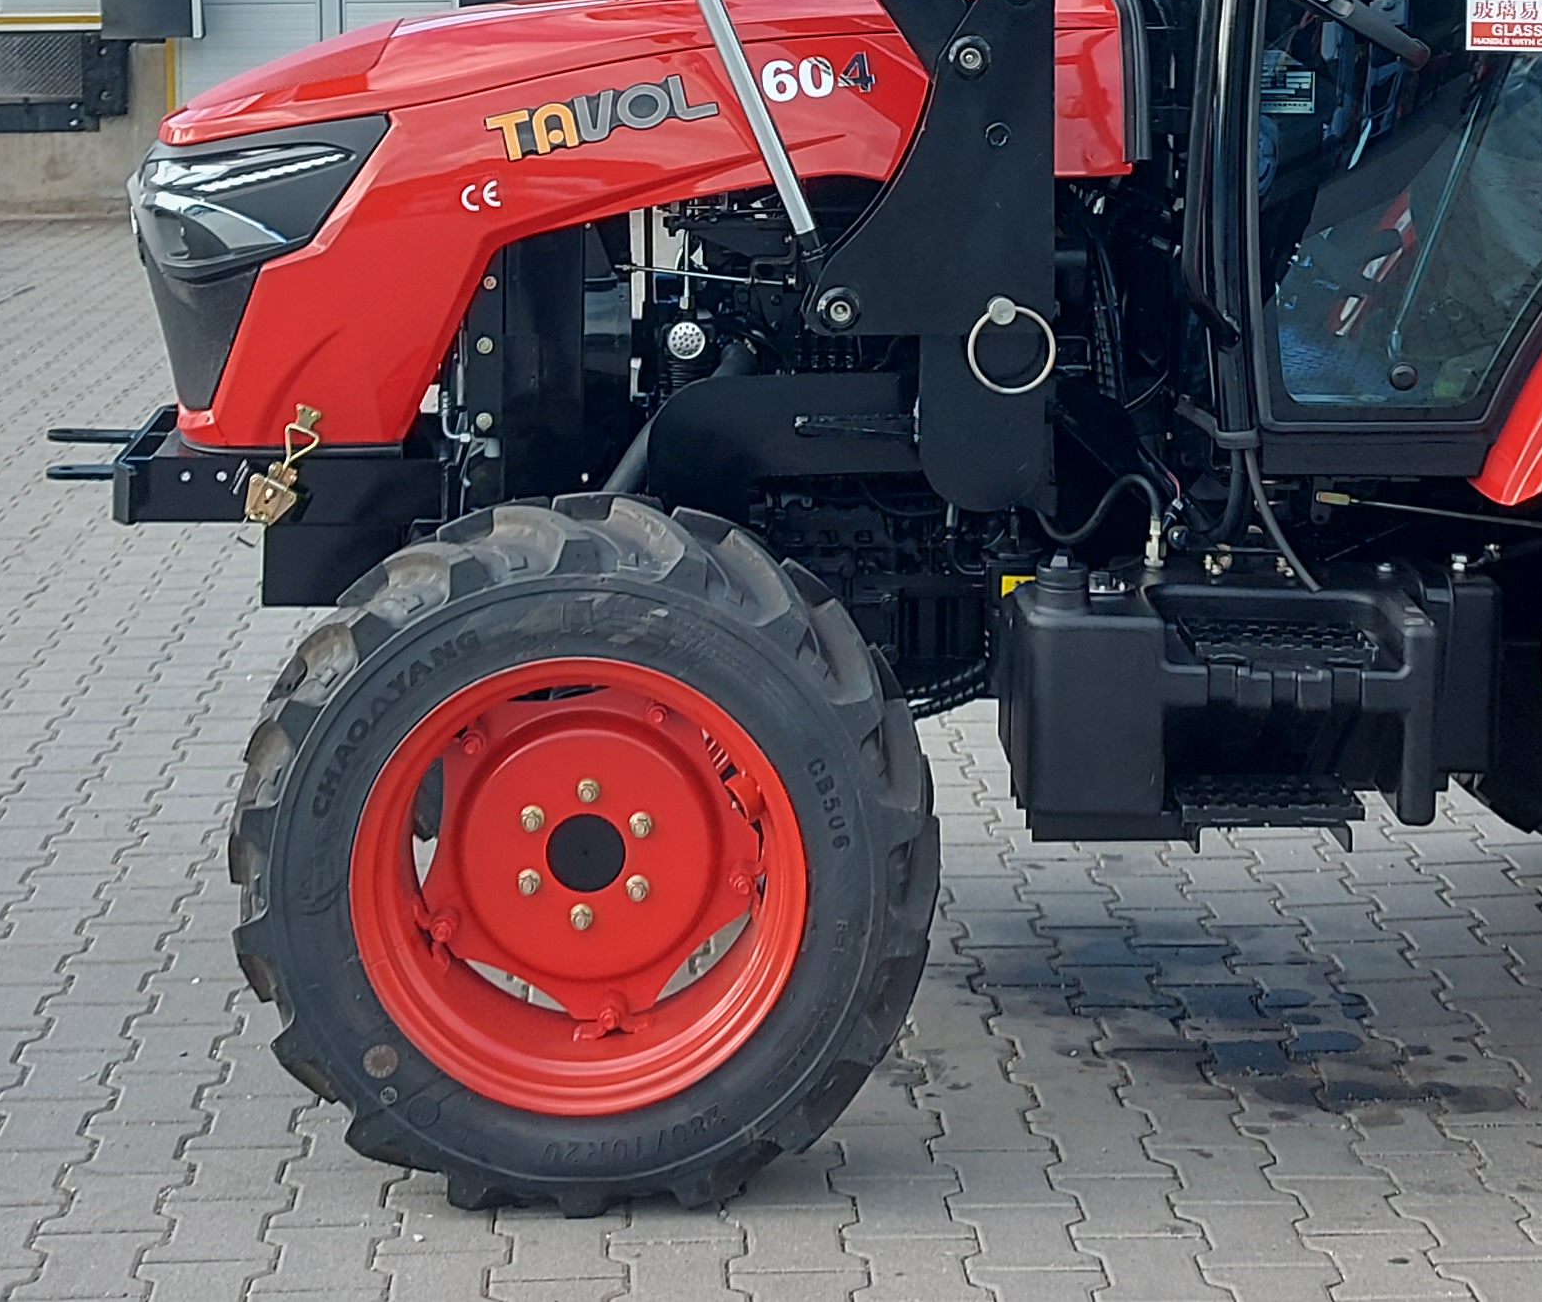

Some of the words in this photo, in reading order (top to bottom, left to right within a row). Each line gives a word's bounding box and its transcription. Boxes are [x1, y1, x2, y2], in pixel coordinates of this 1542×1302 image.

[1473, 37, 1510, 46] HANDLE
[1511, 38, 1535, 46] WITH
[760, 51, 876, 103] 604
[485, 74, 719, 162] TAVOL
[461, 180, 502, 212] CE
[806, 756, 852, 852] CB506
